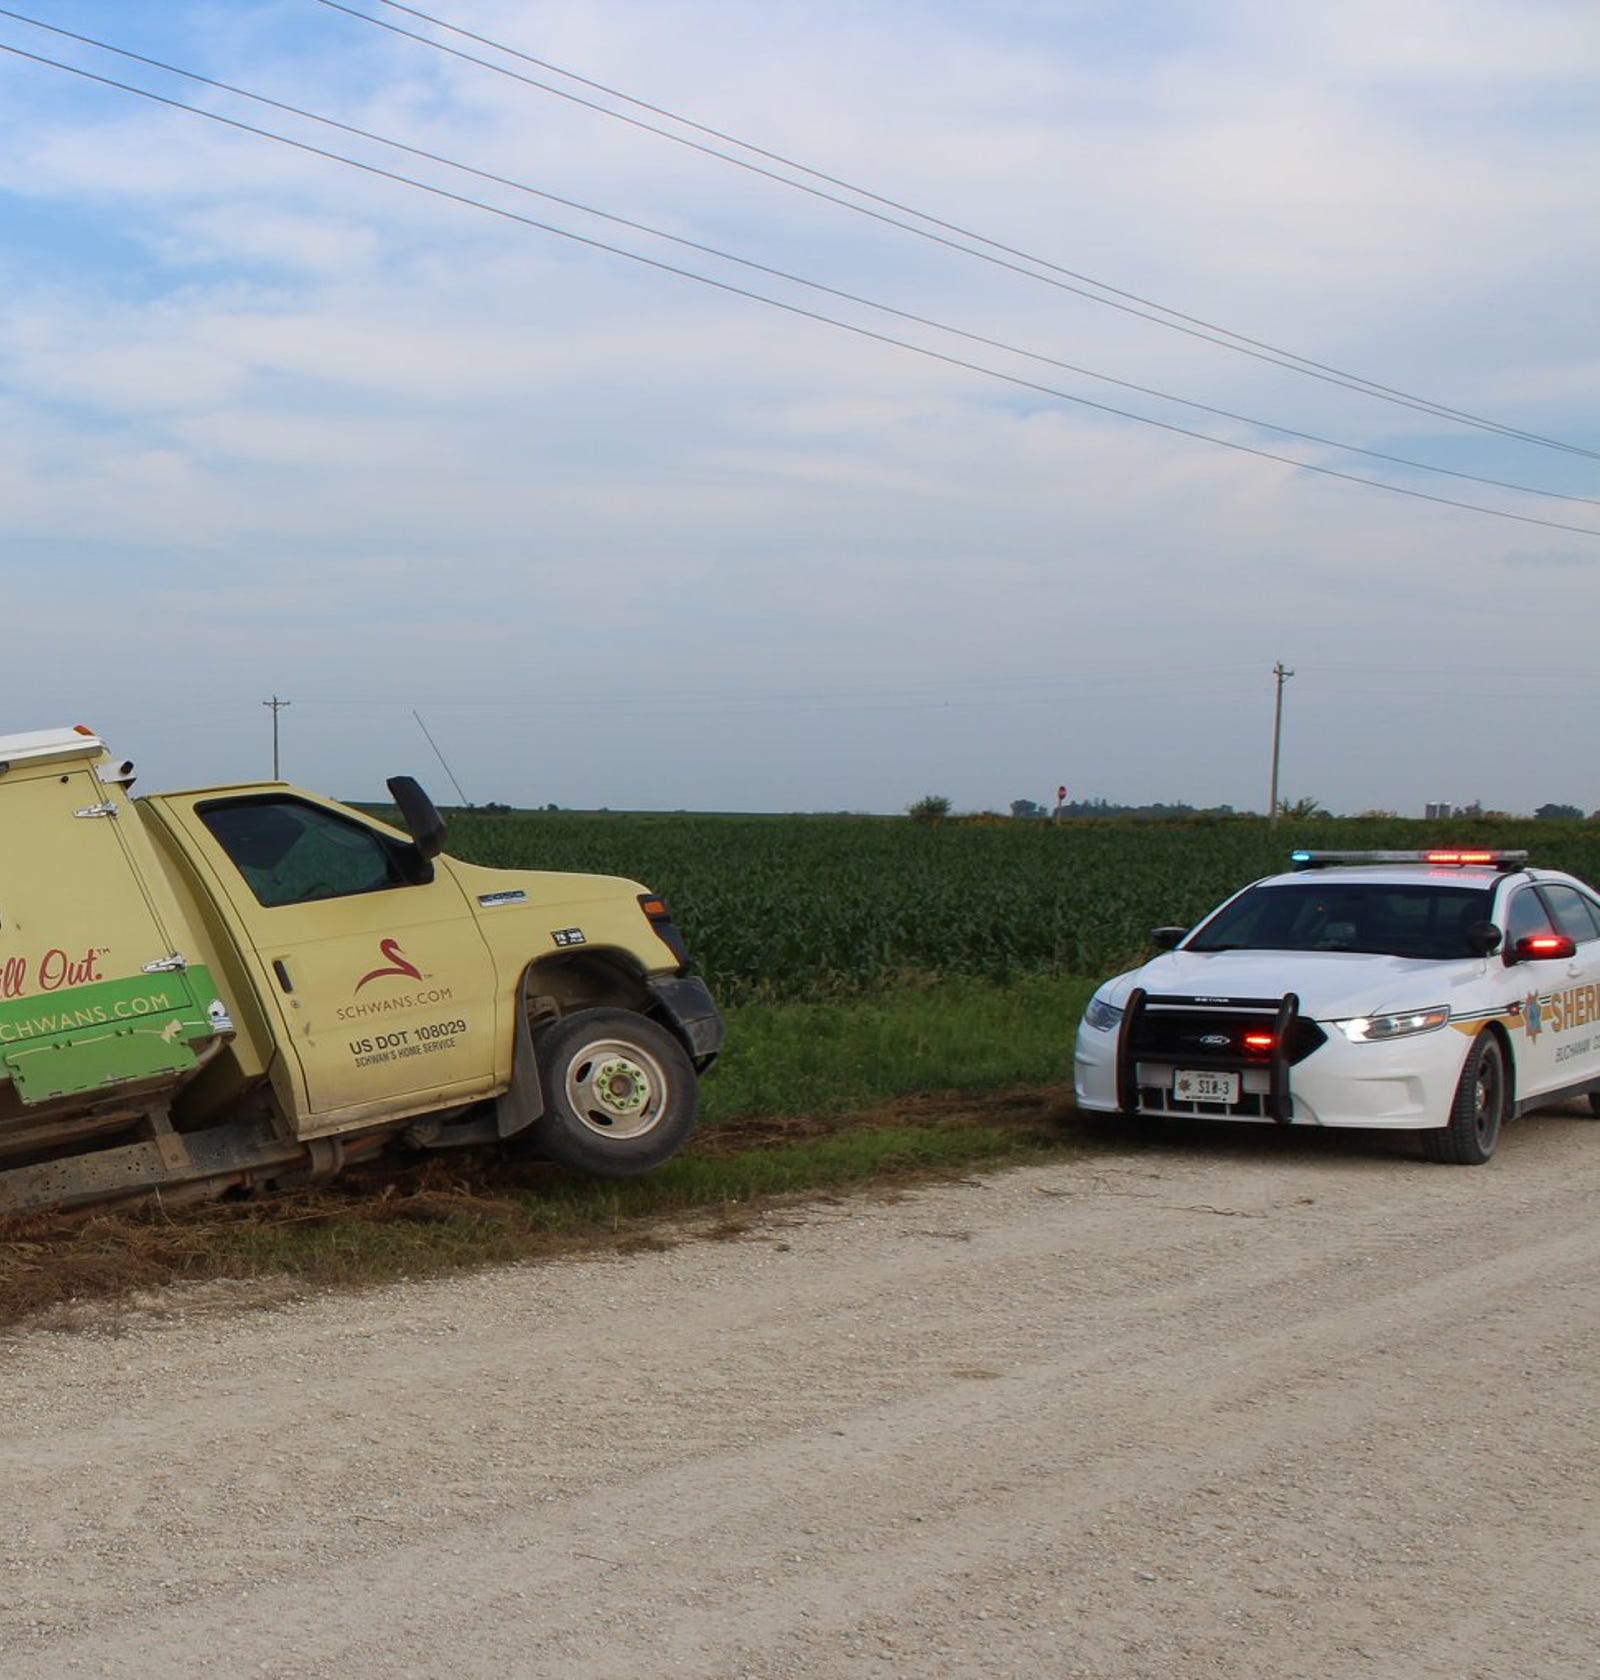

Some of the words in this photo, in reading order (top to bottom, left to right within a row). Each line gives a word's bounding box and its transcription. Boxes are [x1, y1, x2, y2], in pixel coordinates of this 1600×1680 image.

[38, 949, 103, 991] Out.
[336, 988, 454, 1020] SCHWANS.COM
[349, 1038, 373, 1055] US
[375, 1030, 408, 1050] DOT
[414, 1019, 467, 1041] 108029
[399, 1044, 421, 1058] HOME
[422, 1037, 456, 1054] SERVICE
